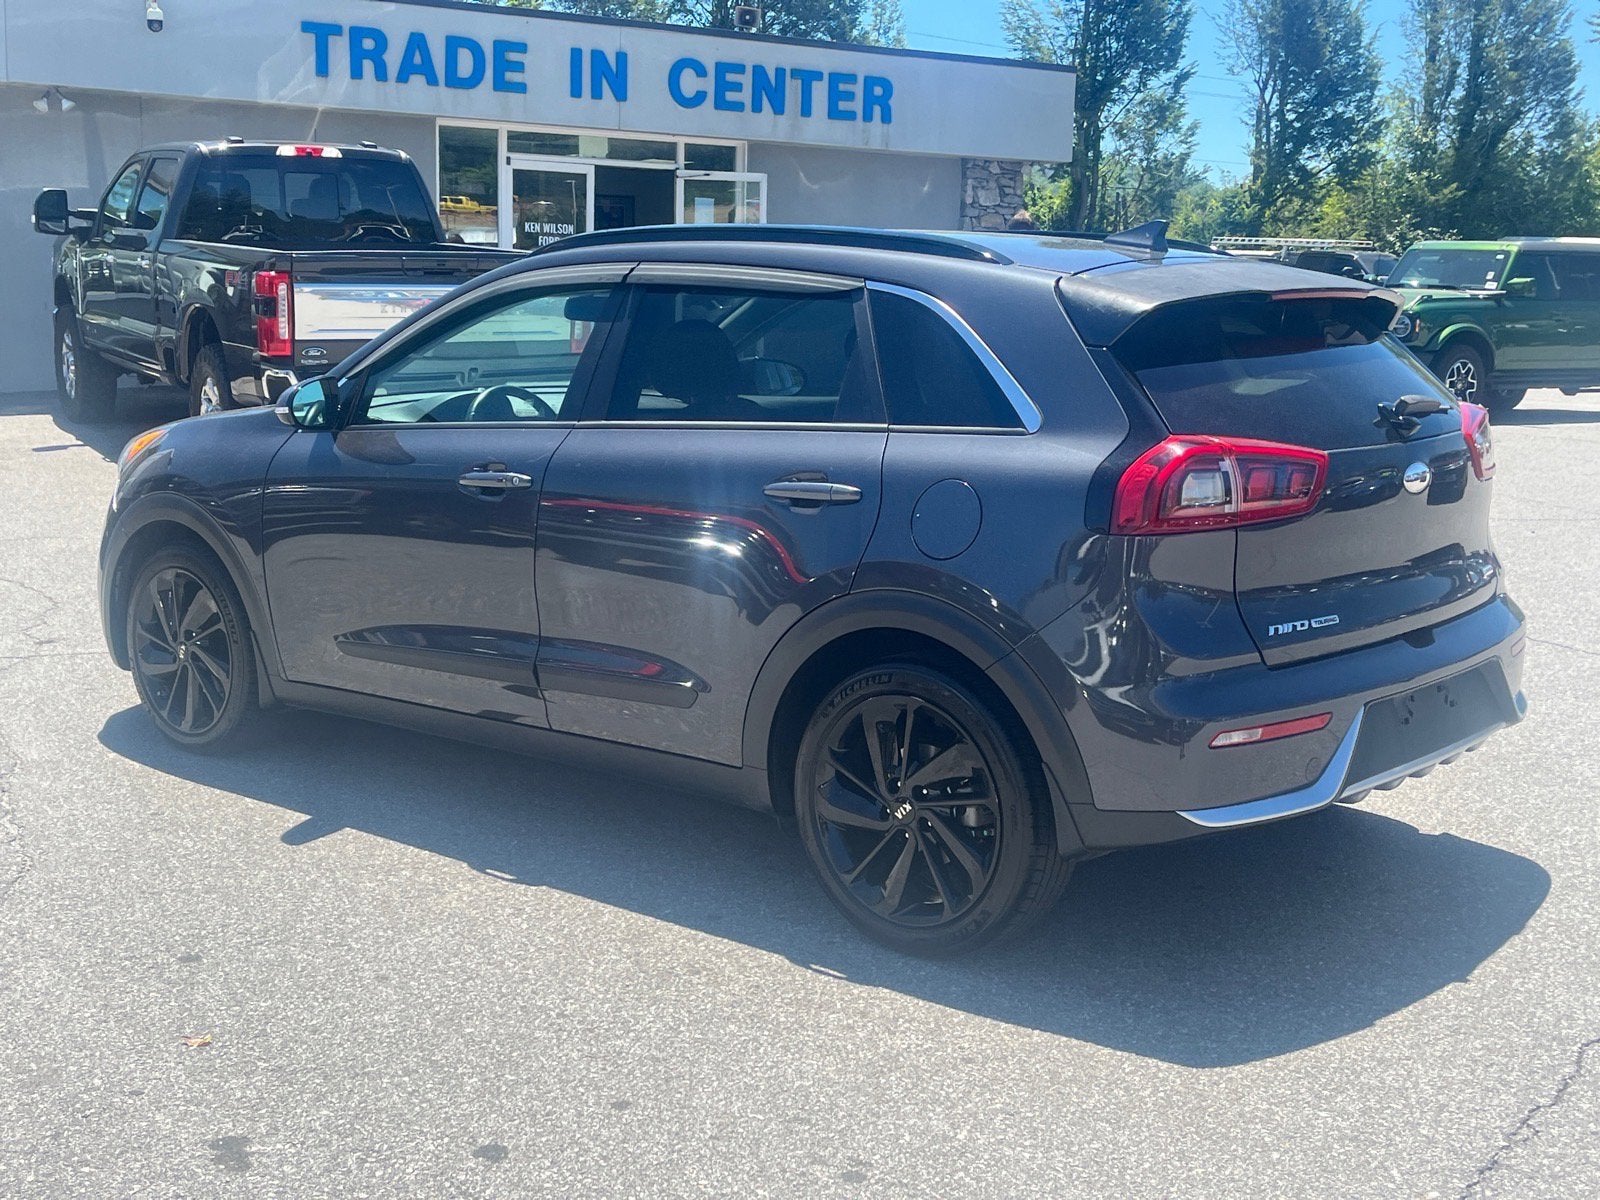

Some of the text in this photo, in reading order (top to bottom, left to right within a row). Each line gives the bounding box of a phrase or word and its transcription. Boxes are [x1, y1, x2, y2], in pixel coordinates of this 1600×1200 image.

[300, 20, 895, 125] TRADE IN CENTER
[524, 222, 574, 235] KEN WILSON
[225, 270, 249, 289] FX4
